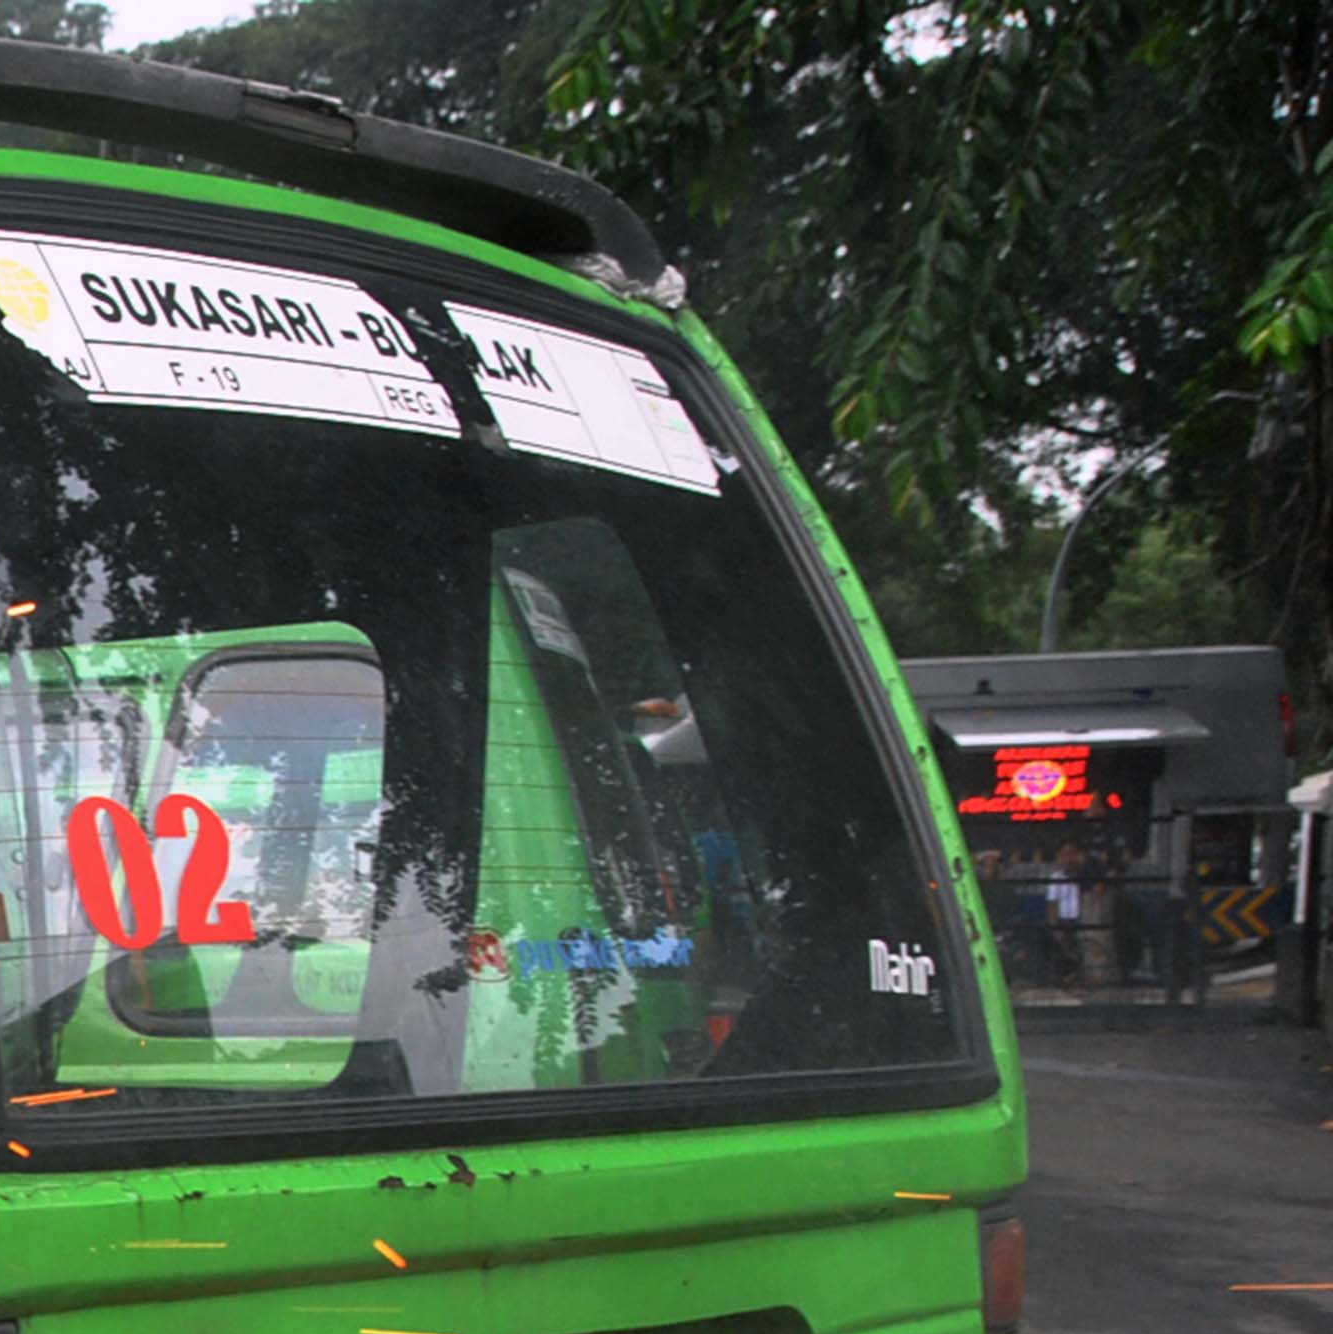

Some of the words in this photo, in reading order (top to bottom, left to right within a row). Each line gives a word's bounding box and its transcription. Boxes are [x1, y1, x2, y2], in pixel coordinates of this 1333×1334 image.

[80, 272, 335, 348] SUKASARI
[383, 385, 439, 416] REG
[65, 793, 258, 950] 02
